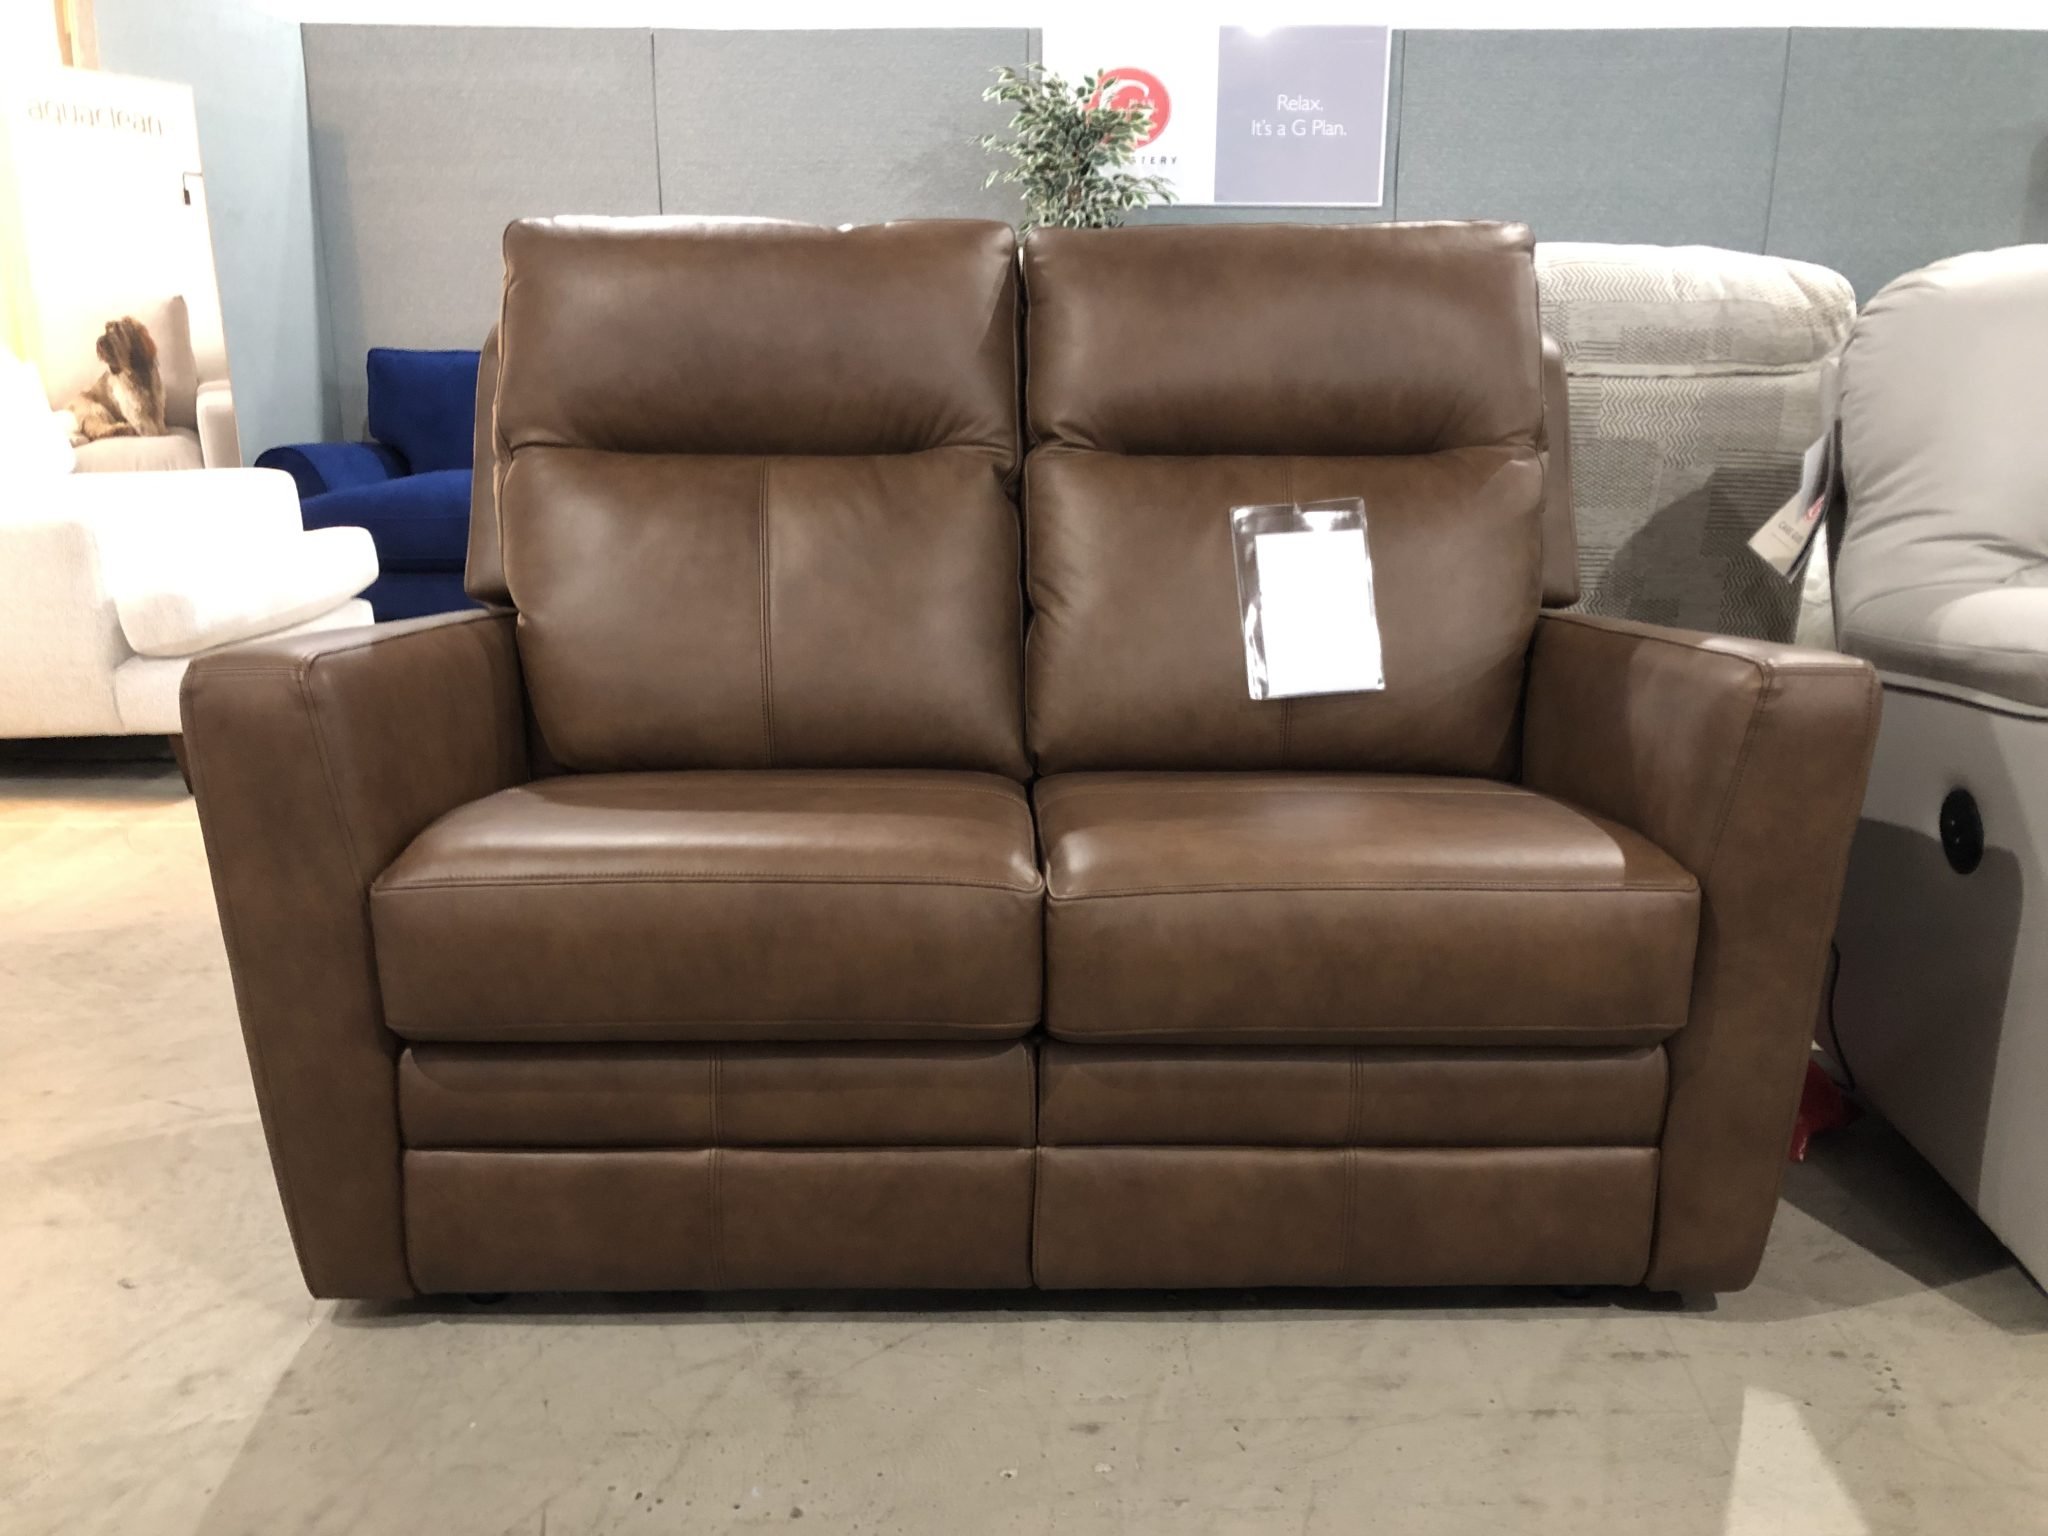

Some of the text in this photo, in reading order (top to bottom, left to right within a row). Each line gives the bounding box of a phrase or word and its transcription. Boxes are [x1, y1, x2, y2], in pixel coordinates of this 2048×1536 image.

[1251, 118, 1347, 136] It's a G Plan.
